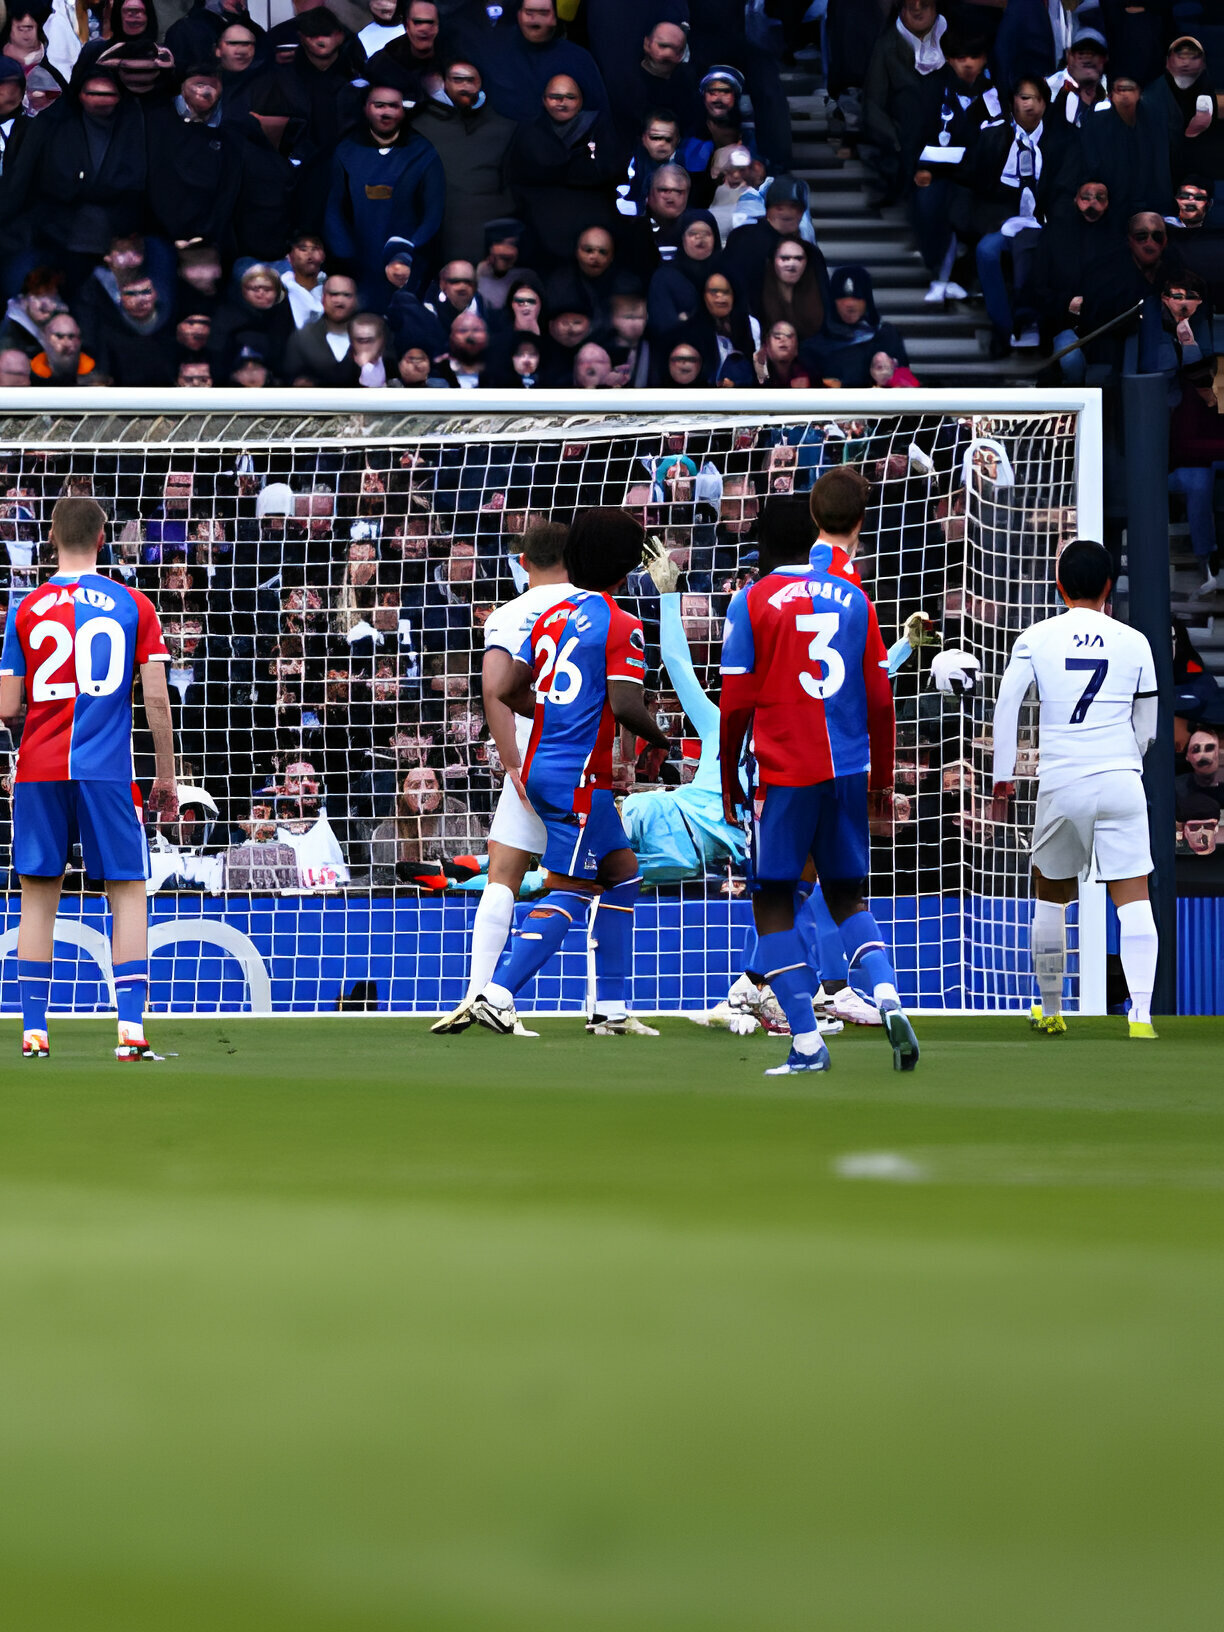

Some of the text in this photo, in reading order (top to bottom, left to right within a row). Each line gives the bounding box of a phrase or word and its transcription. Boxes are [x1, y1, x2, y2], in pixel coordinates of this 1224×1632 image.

[29, 617, 126, 703] 20
[534, 634, 583, 705] 26
[795, 612, 846, 700] 3
[1065, 658, 1109, 724] 7
